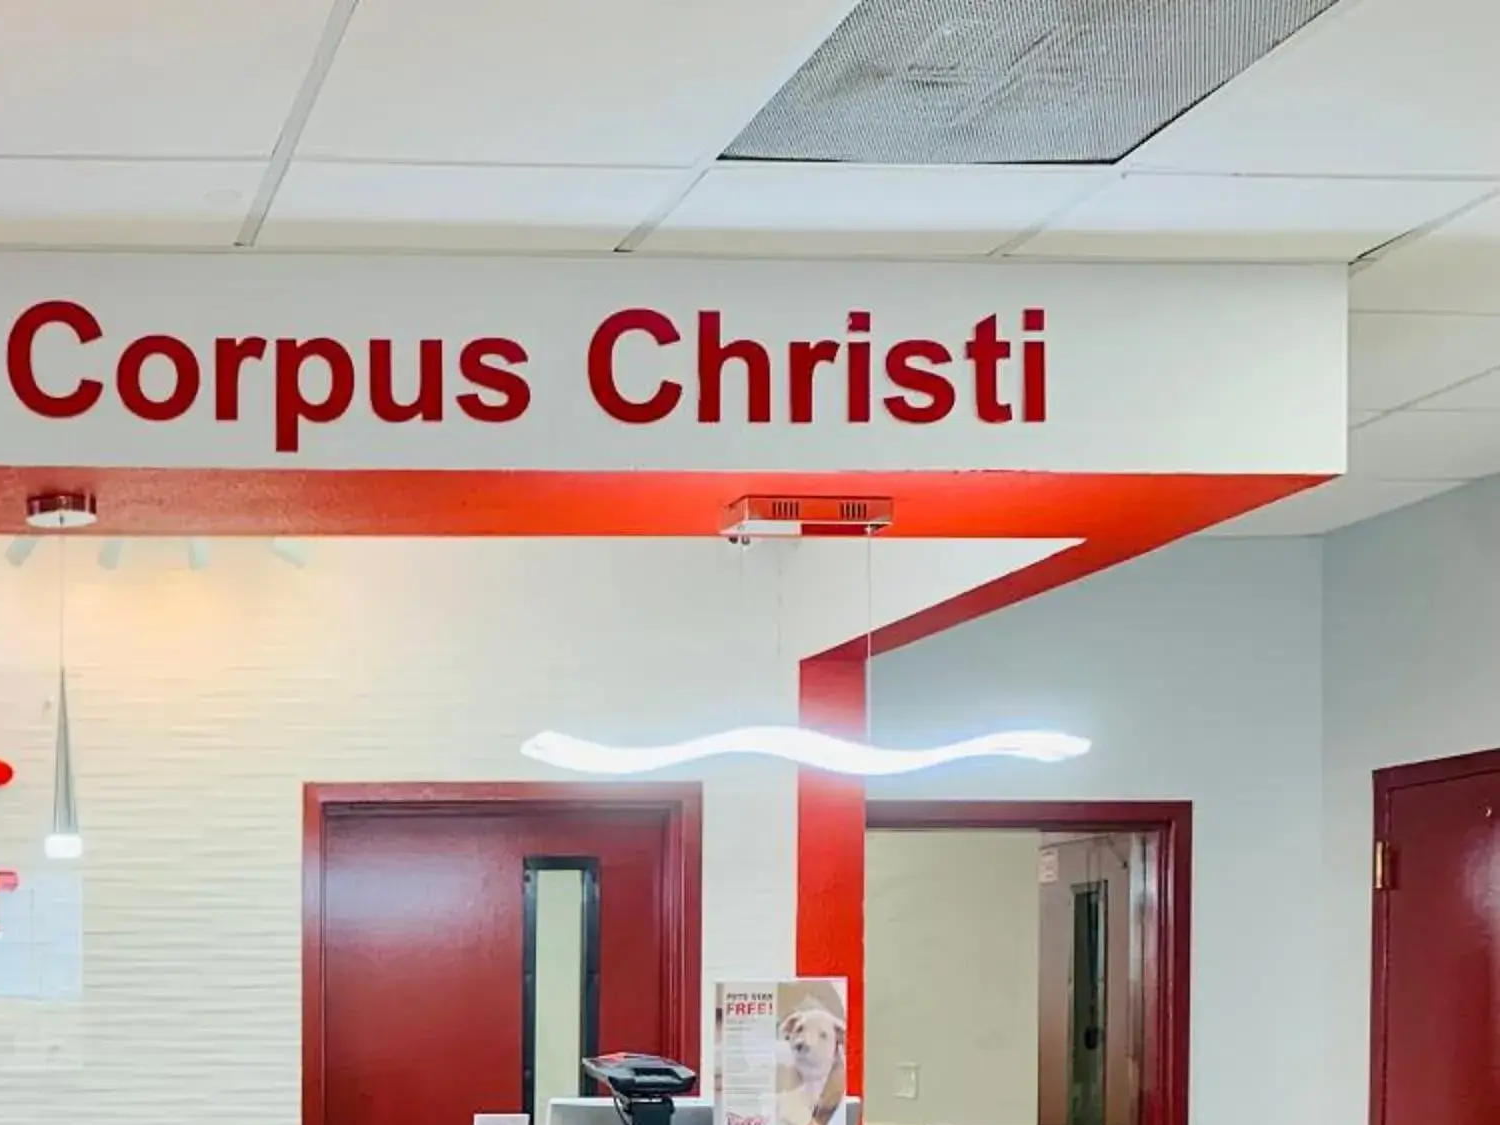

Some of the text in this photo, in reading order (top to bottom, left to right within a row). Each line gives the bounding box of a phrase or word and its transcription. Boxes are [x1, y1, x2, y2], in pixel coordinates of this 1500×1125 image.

[6, 299, 531, 453] Corpus
[587, 306, 1047, 425] Christi
[726, 1002, 773, 1015] FREE!
